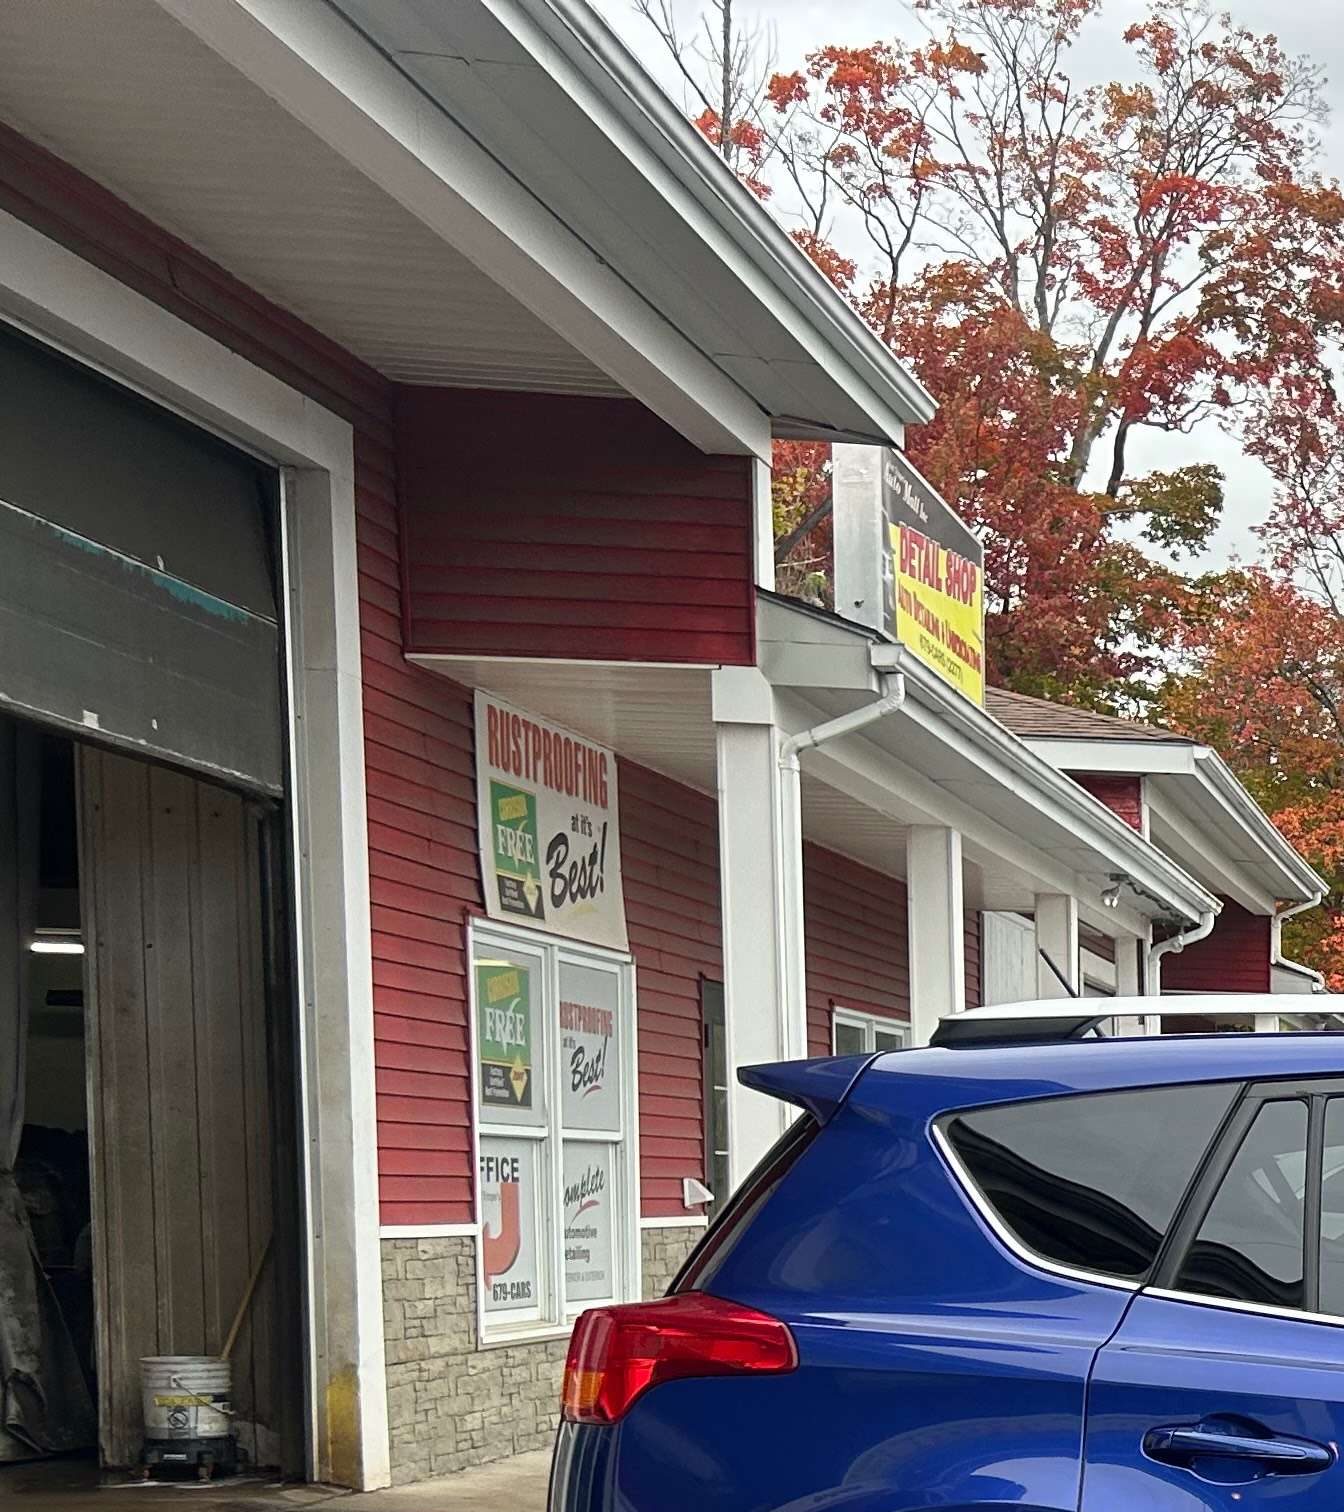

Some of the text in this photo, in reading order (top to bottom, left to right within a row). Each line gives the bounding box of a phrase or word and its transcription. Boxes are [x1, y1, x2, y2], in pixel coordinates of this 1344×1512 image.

[900, 522, 977, 608] DETAIL SHOP
[487, 703, 608, 810] RUSTPROOFING
[495, 824, 535, 865] FREE
[571, 814, 593, 838] at it's
[546, 821, 608, 909] Best!
[485, 1006, 526, 1047] FREE
[570, 1035, 607, 1092] Best!
[480, 1156, 520, 1183] FFICE
[564, 1164, 605, 1208] omplete
[565, 1225, 597, 1239] utomotive
[565, 1245, 590, 1263] etailing
[493, 1280, 531, 1301] 679-CARS
